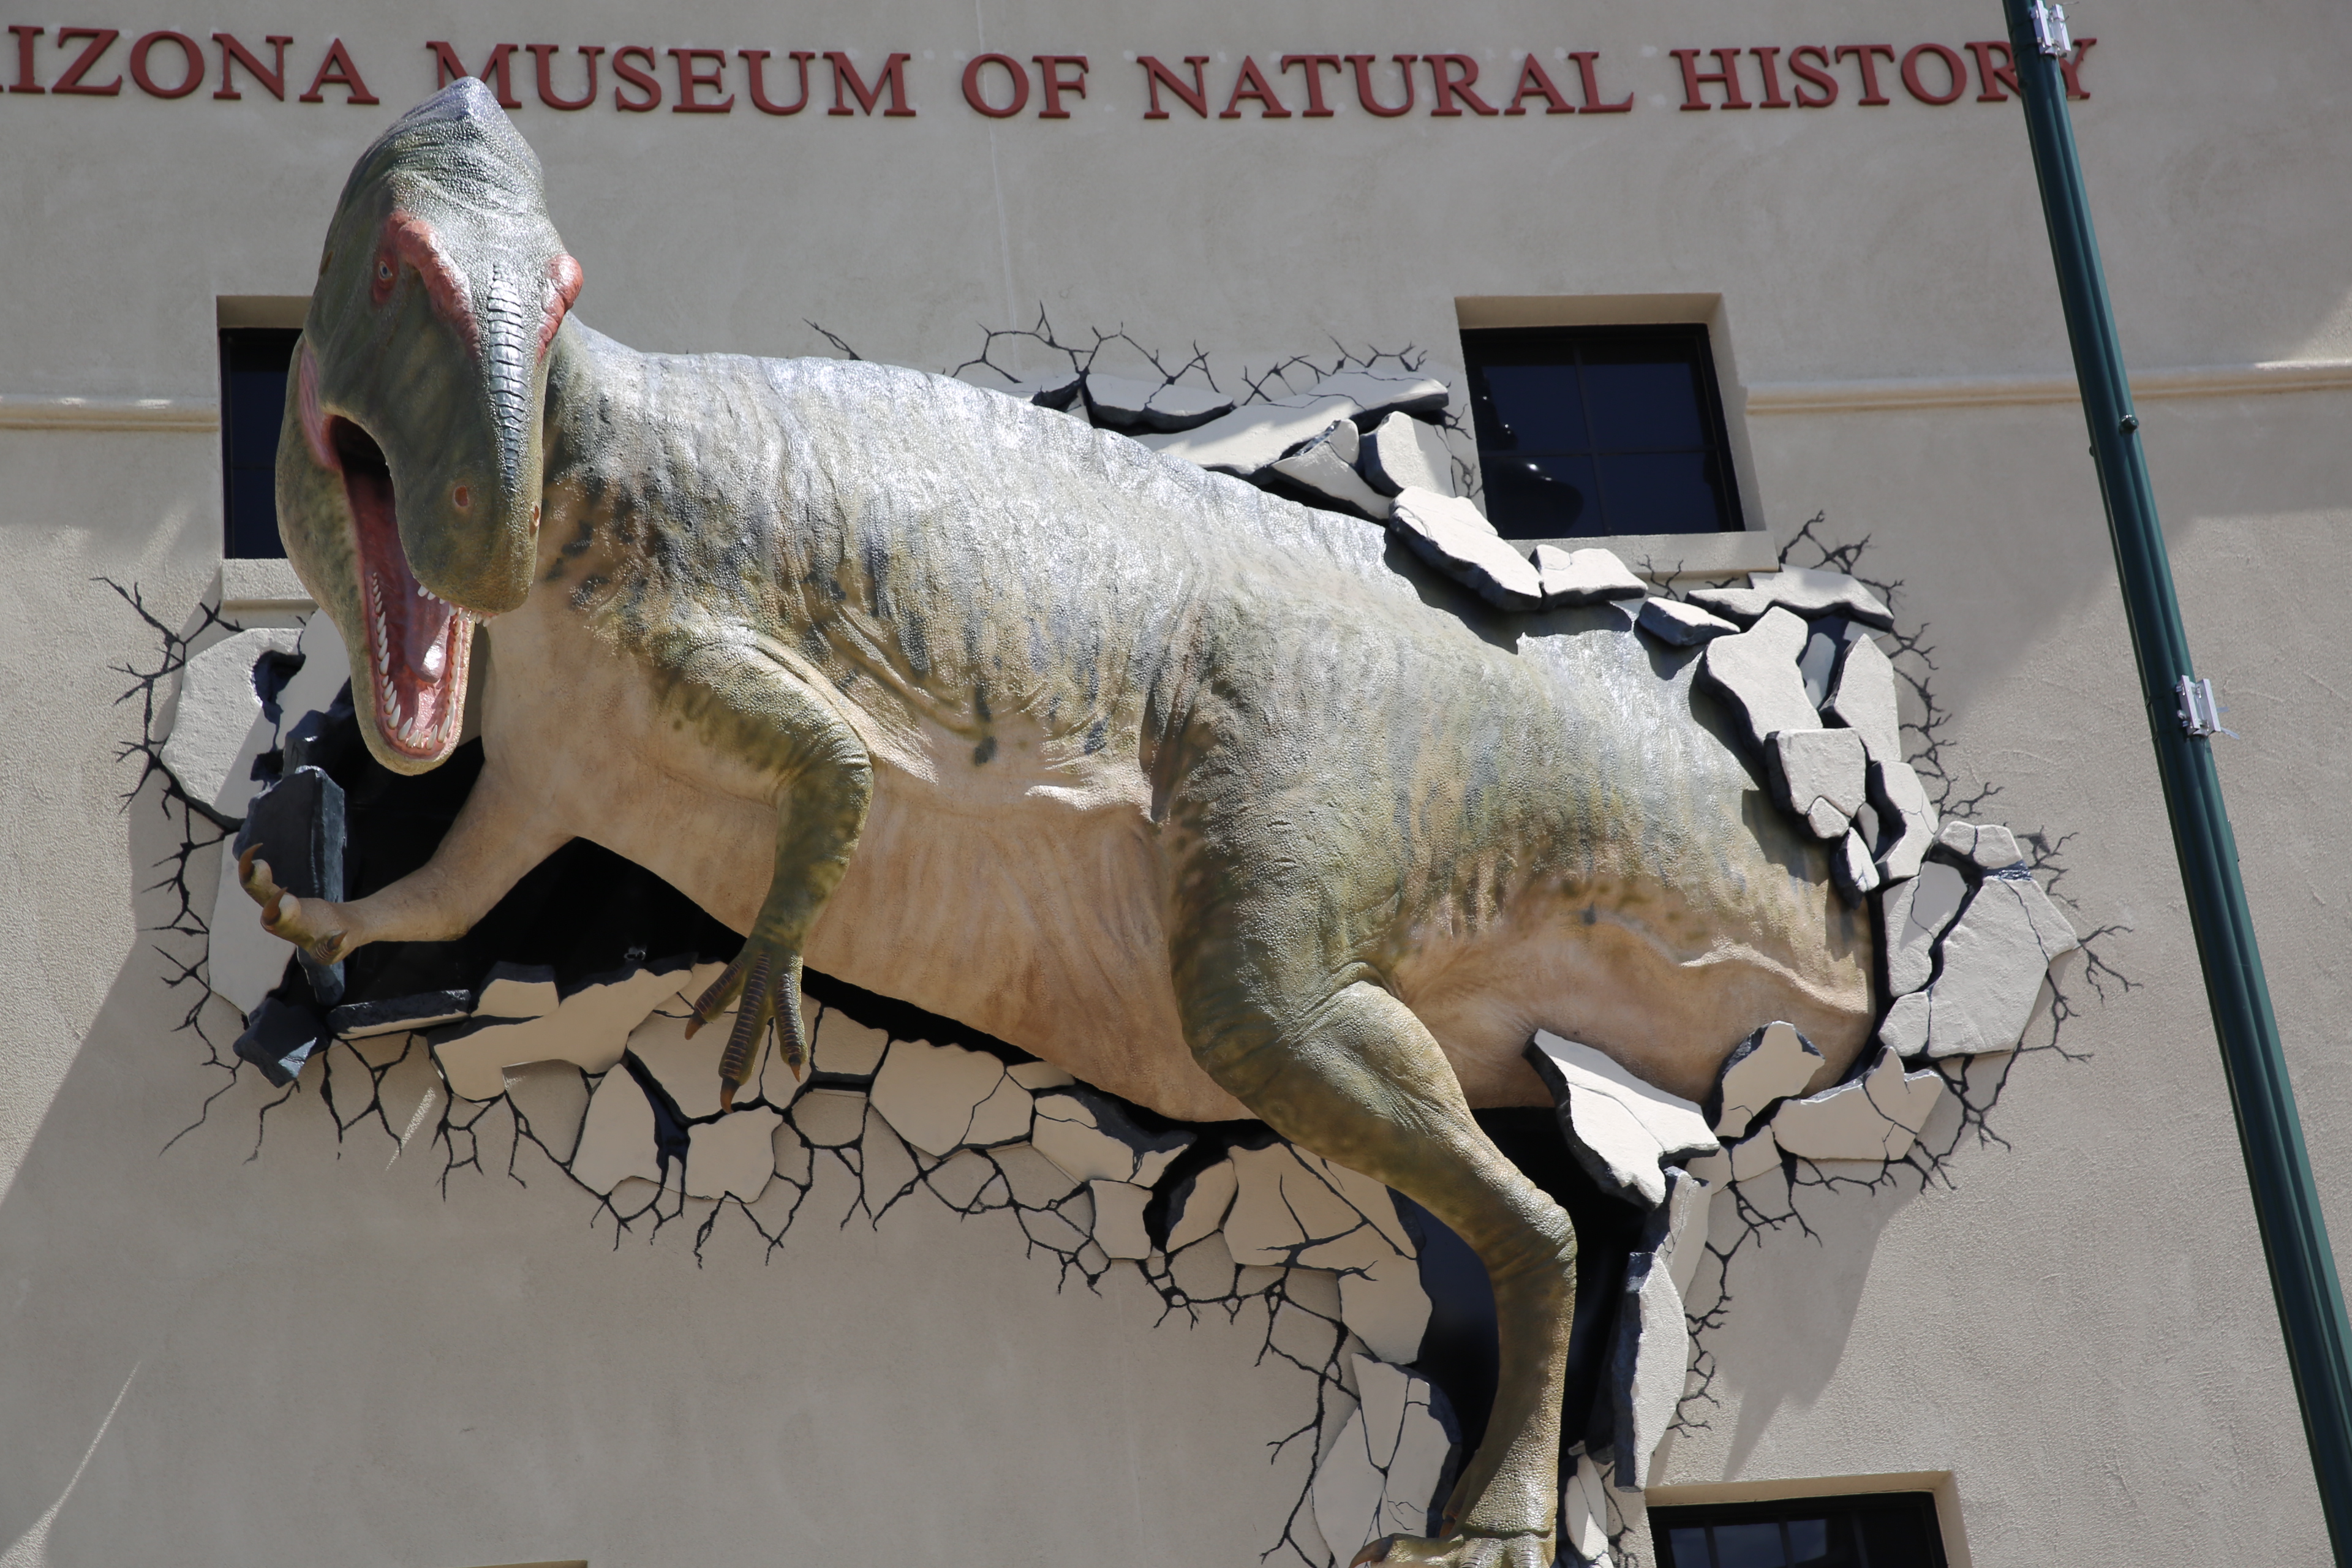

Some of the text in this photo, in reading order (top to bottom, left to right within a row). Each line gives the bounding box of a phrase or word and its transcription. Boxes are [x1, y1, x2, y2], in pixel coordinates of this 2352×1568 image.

[0, 25, 2098, 118] IZONA MUSEUM OF NATURAL HISTORY
